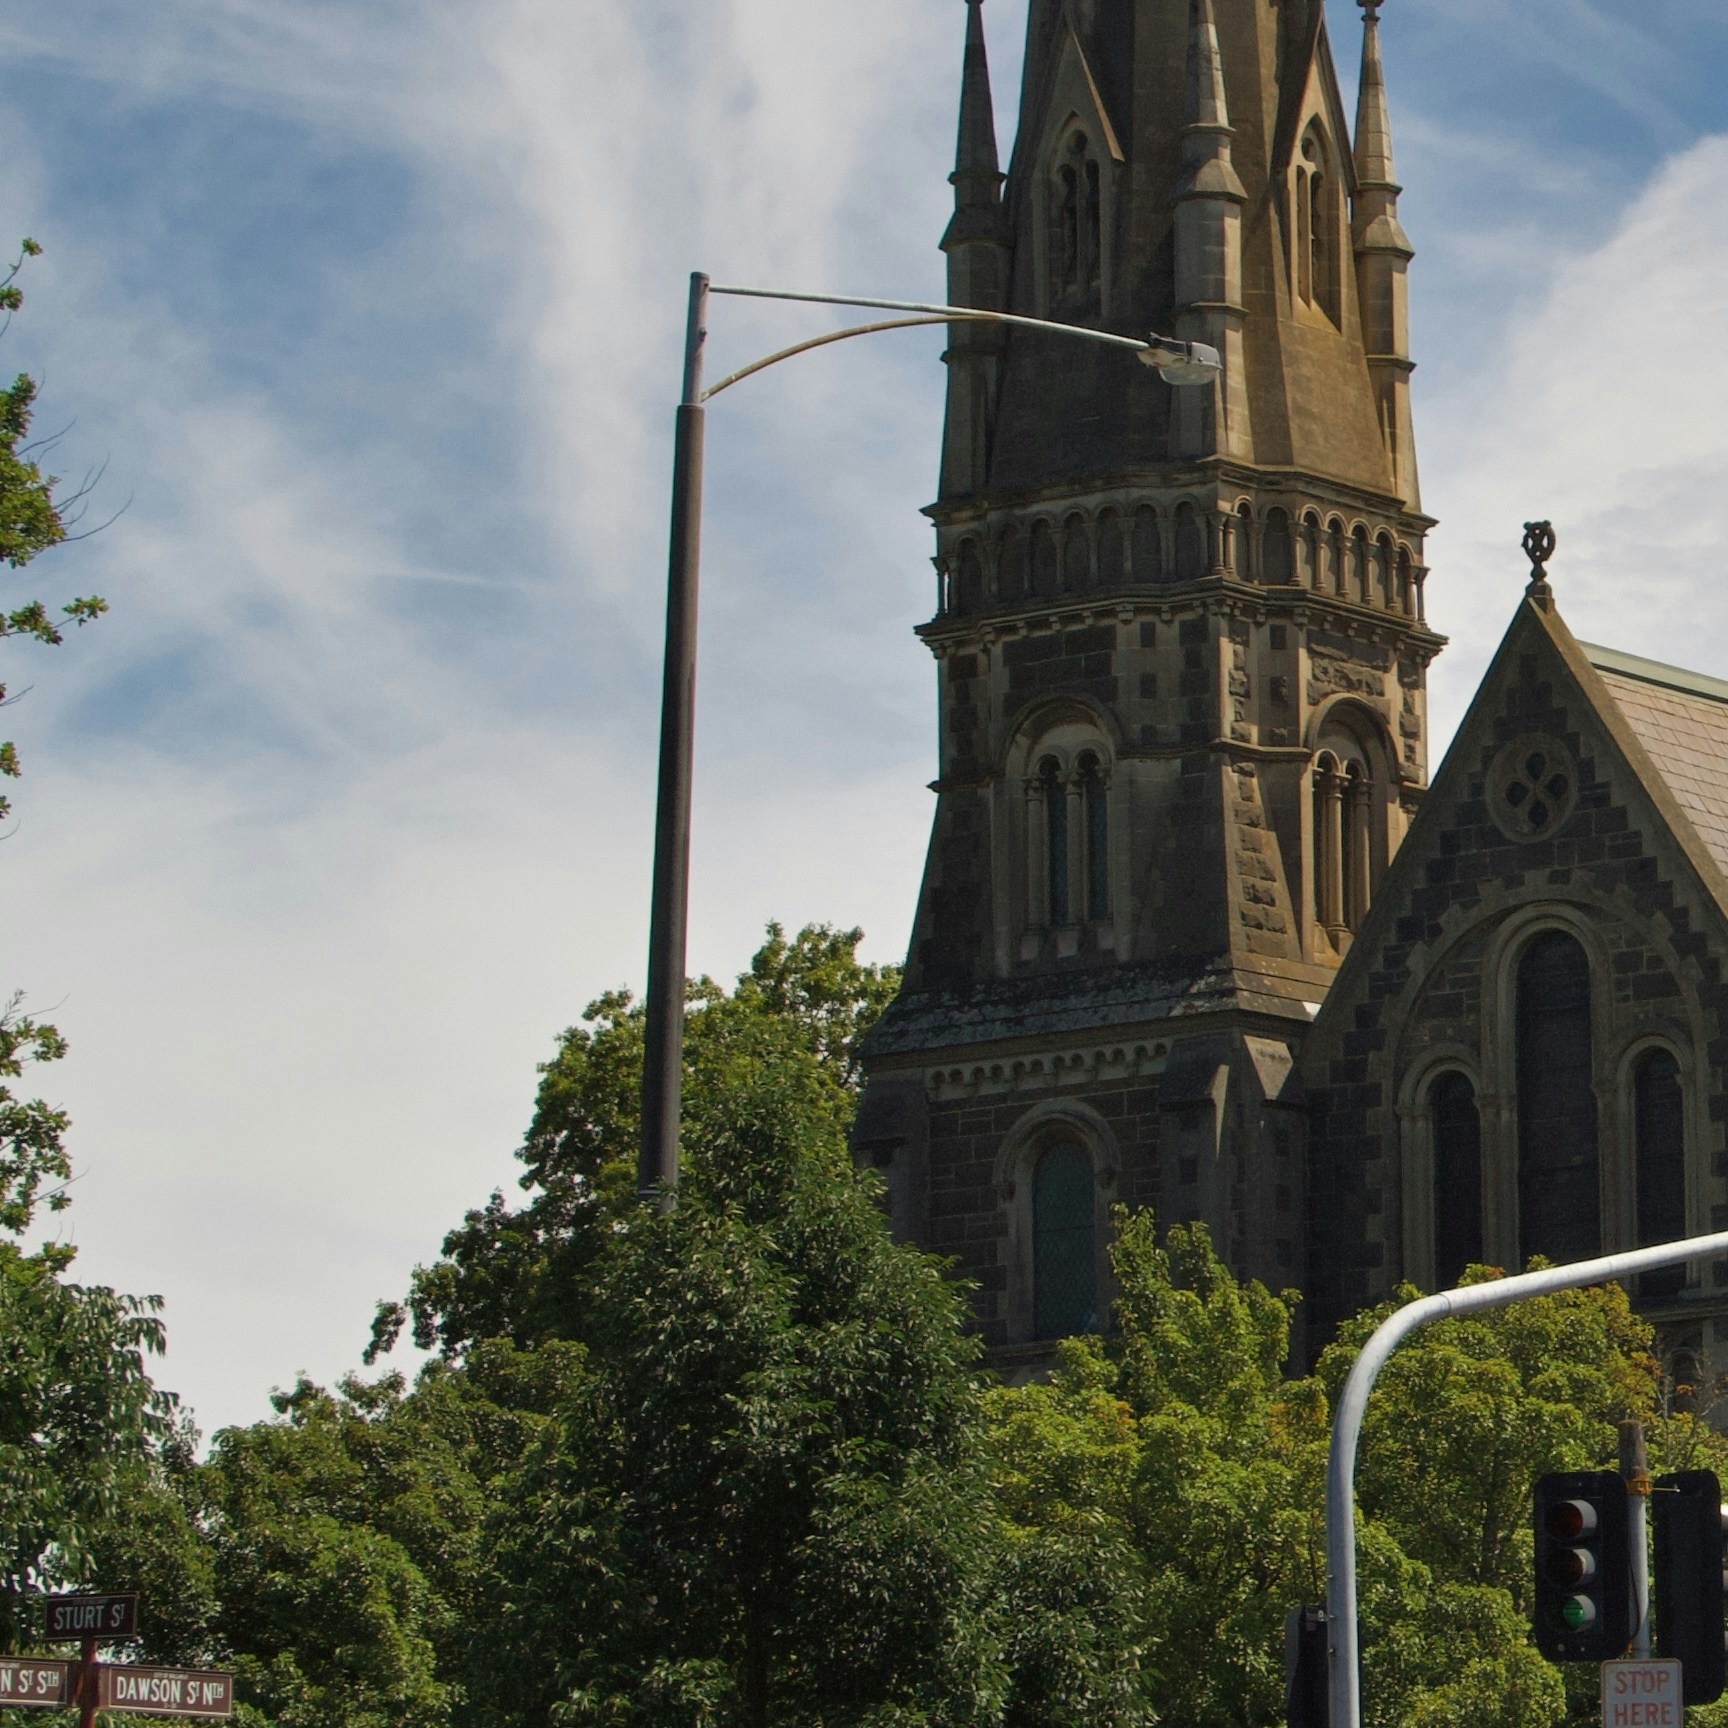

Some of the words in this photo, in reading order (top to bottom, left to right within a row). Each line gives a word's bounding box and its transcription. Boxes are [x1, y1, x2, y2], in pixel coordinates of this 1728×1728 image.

[54, 1605, 104, 1631] STURT
[116, 1676, 182, 1703] DAWSON
[1615, 1670, 1670, 1694] STOP
[1614, 1702, 1673, 1727] HERE
